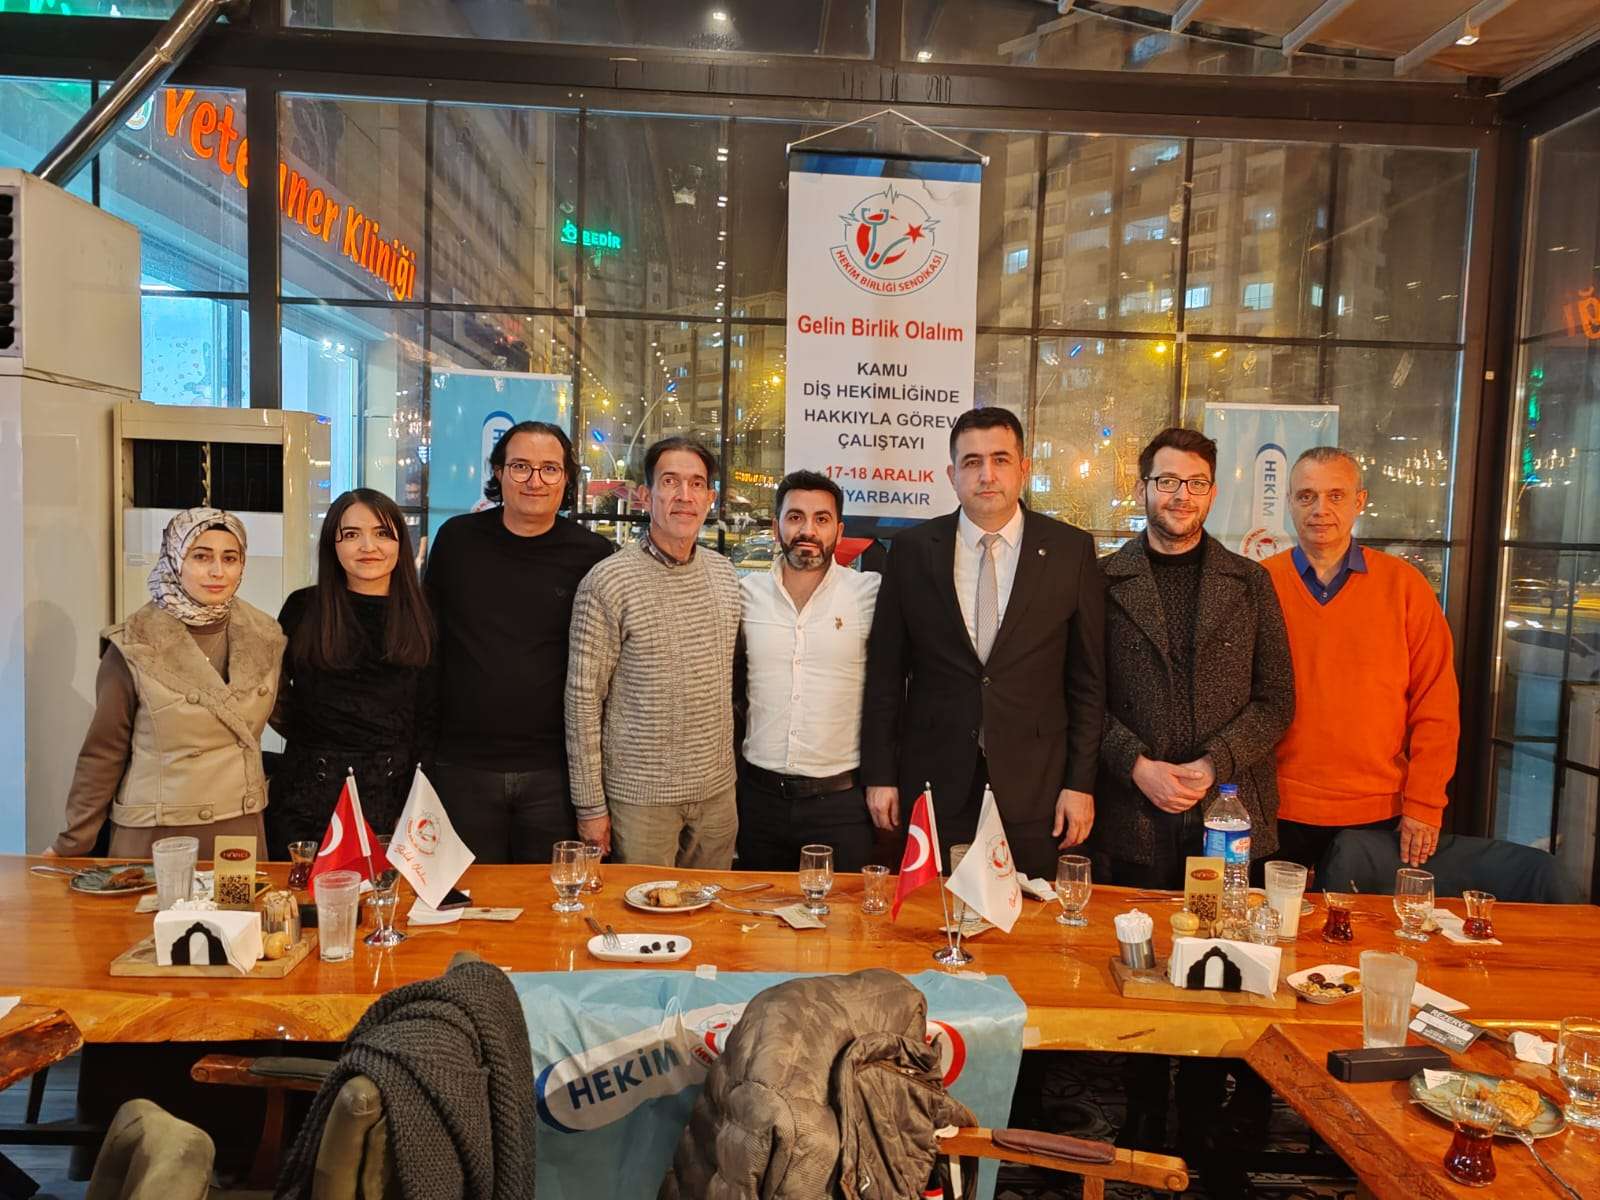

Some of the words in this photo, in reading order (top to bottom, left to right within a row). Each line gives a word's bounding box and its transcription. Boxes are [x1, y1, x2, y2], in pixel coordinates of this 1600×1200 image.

[164, 87, 341, 242] Veteiner
[341, 206, 417, 301] Kliniği
[836, 249, 860, 280] HEKİM
[860, 275, 897, 293] BİRLİĞİ
[898, 254, 943, 293] SENDİKASI
[797, 314, 845, 336] Gelin
[851, 317, 899, 338] Birlik
[905, 320, 964, 342] Olalım
[857, 362, 908, 378] KAMU
[803, 379, 831, 399] DİŞ
[836, 382, 960, 404] HEKİMLİĞİNDE
[804, 408, 892, 426] HAKKIYLA
[896, 411, 958, 429] GÖREV
[837, 432, 925, 451] ÇALIŞTAYI
[826, 465, 867, 480] 17-18
[872, 467, 935, 484] ARALIK
[841, 486, 930, 506] İYARBAKIR
[1262, 460, 1279, 517] HEKİM
[566, 1040, 681, 1110] HEKİM
